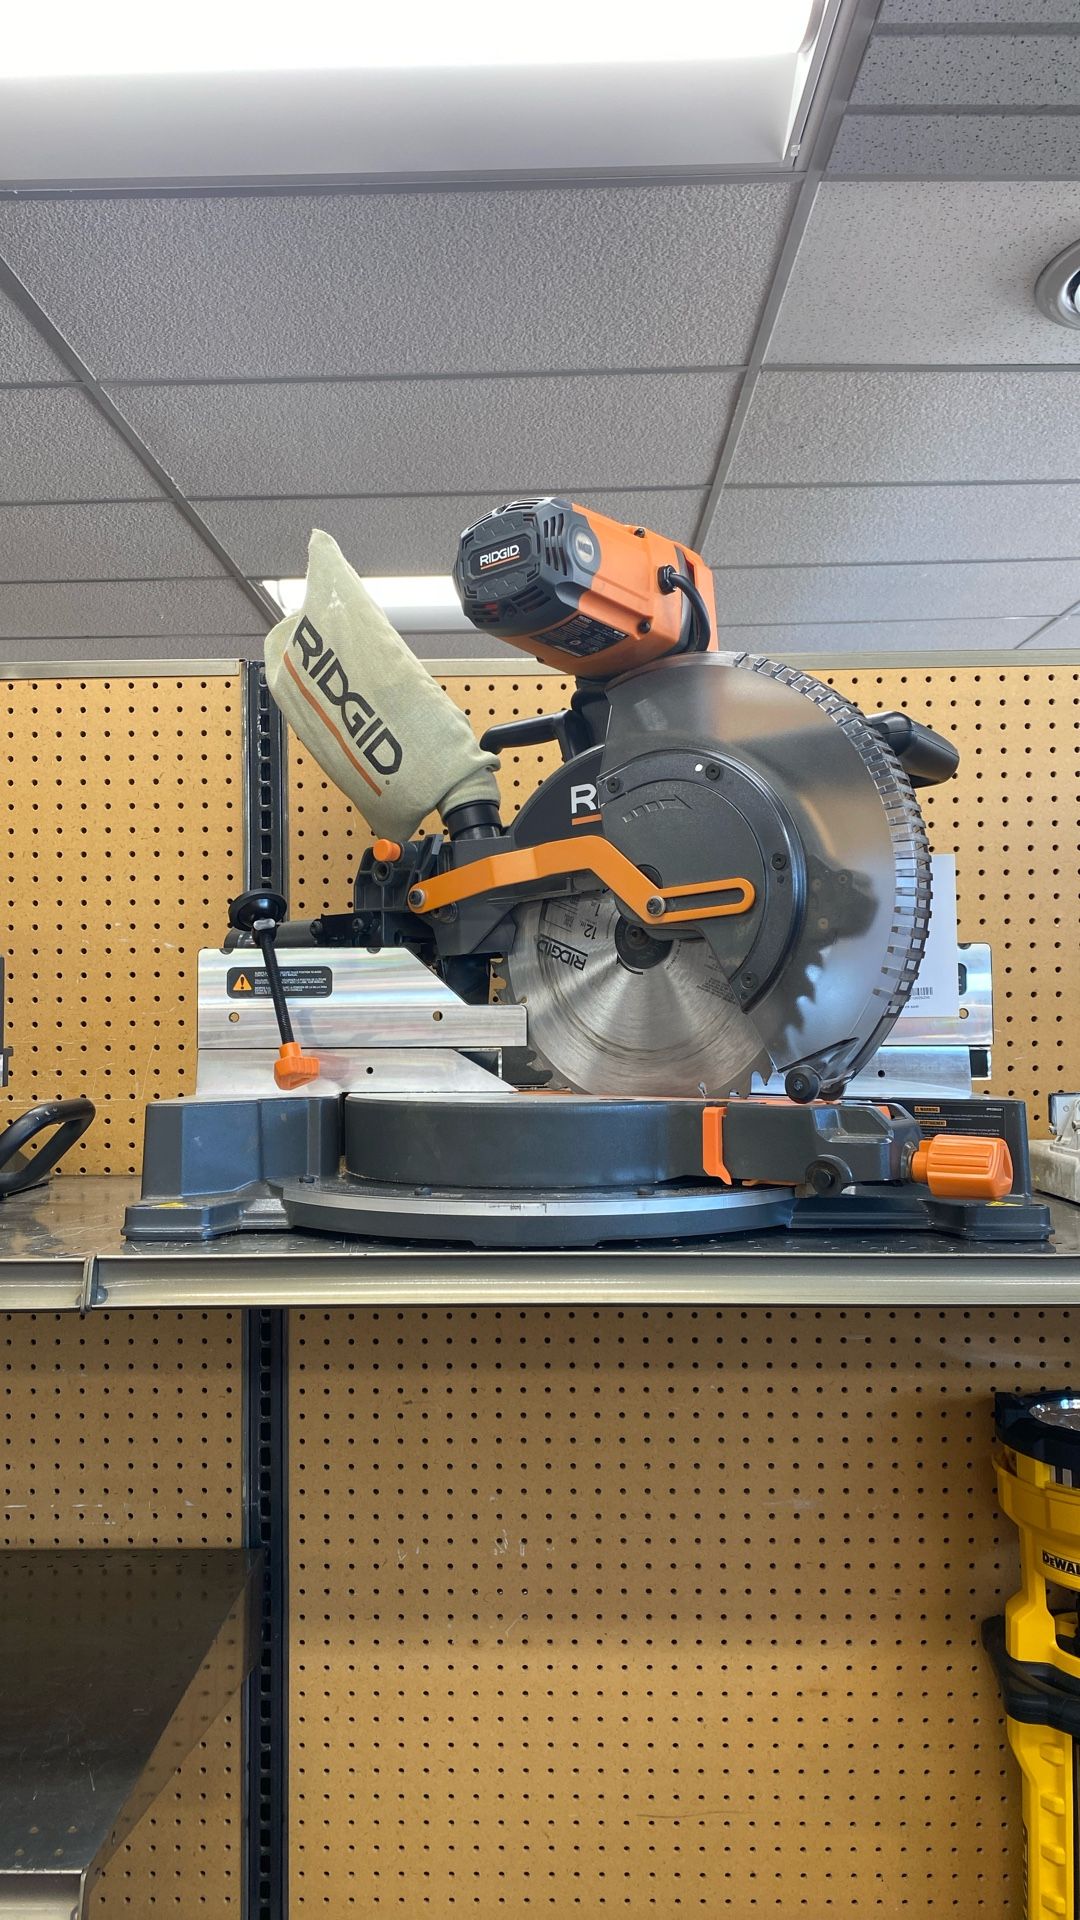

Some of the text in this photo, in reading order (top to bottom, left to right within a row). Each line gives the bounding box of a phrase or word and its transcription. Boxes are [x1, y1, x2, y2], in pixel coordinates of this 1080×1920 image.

[479, 545, 520, 566] RIDGID
[293, 614, 403, 776] RIDGID
[570, 783, 600, 814] R
[583, 924, 597, 940] 12
[536, 939, 587, 971] RIDGID
